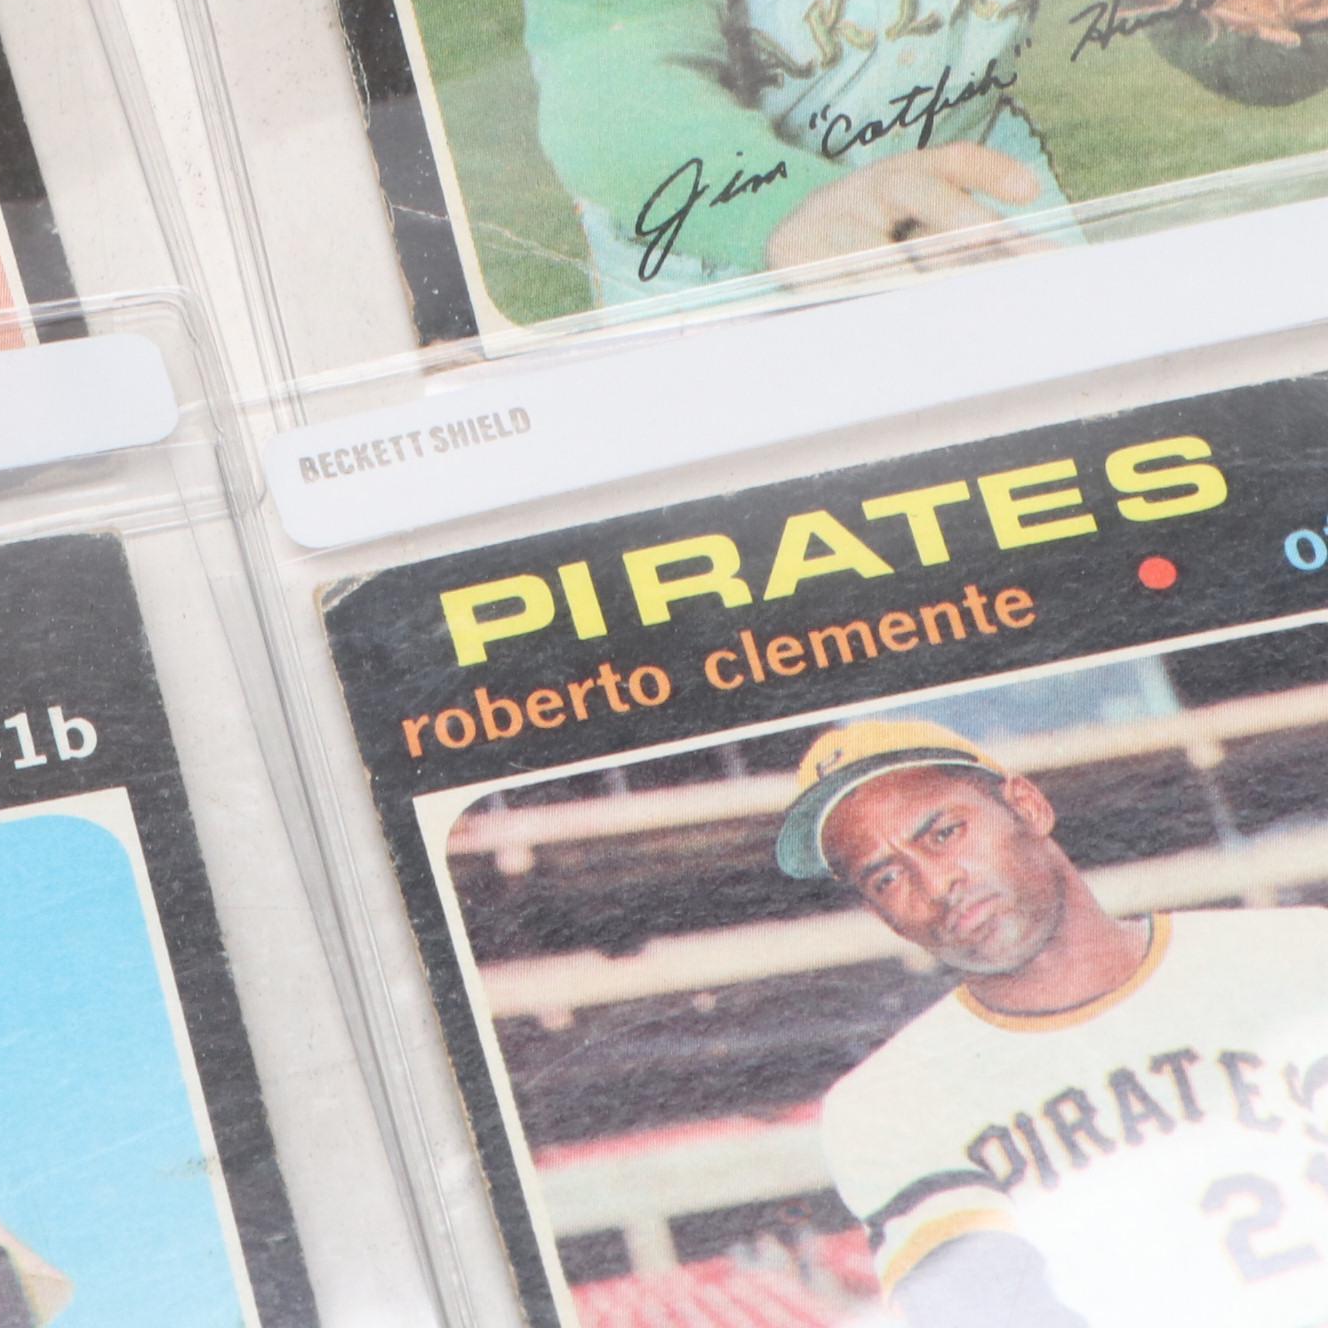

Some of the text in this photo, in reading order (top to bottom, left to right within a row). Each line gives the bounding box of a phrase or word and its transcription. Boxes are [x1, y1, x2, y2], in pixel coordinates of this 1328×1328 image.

[635, 152, 788, 282] Jim
[298, 407, 532, 484] BECKETT SHIELD
[440, 435, 1228, 668] PIRATES
[402, 584, 1037, 759] roberto clemente
